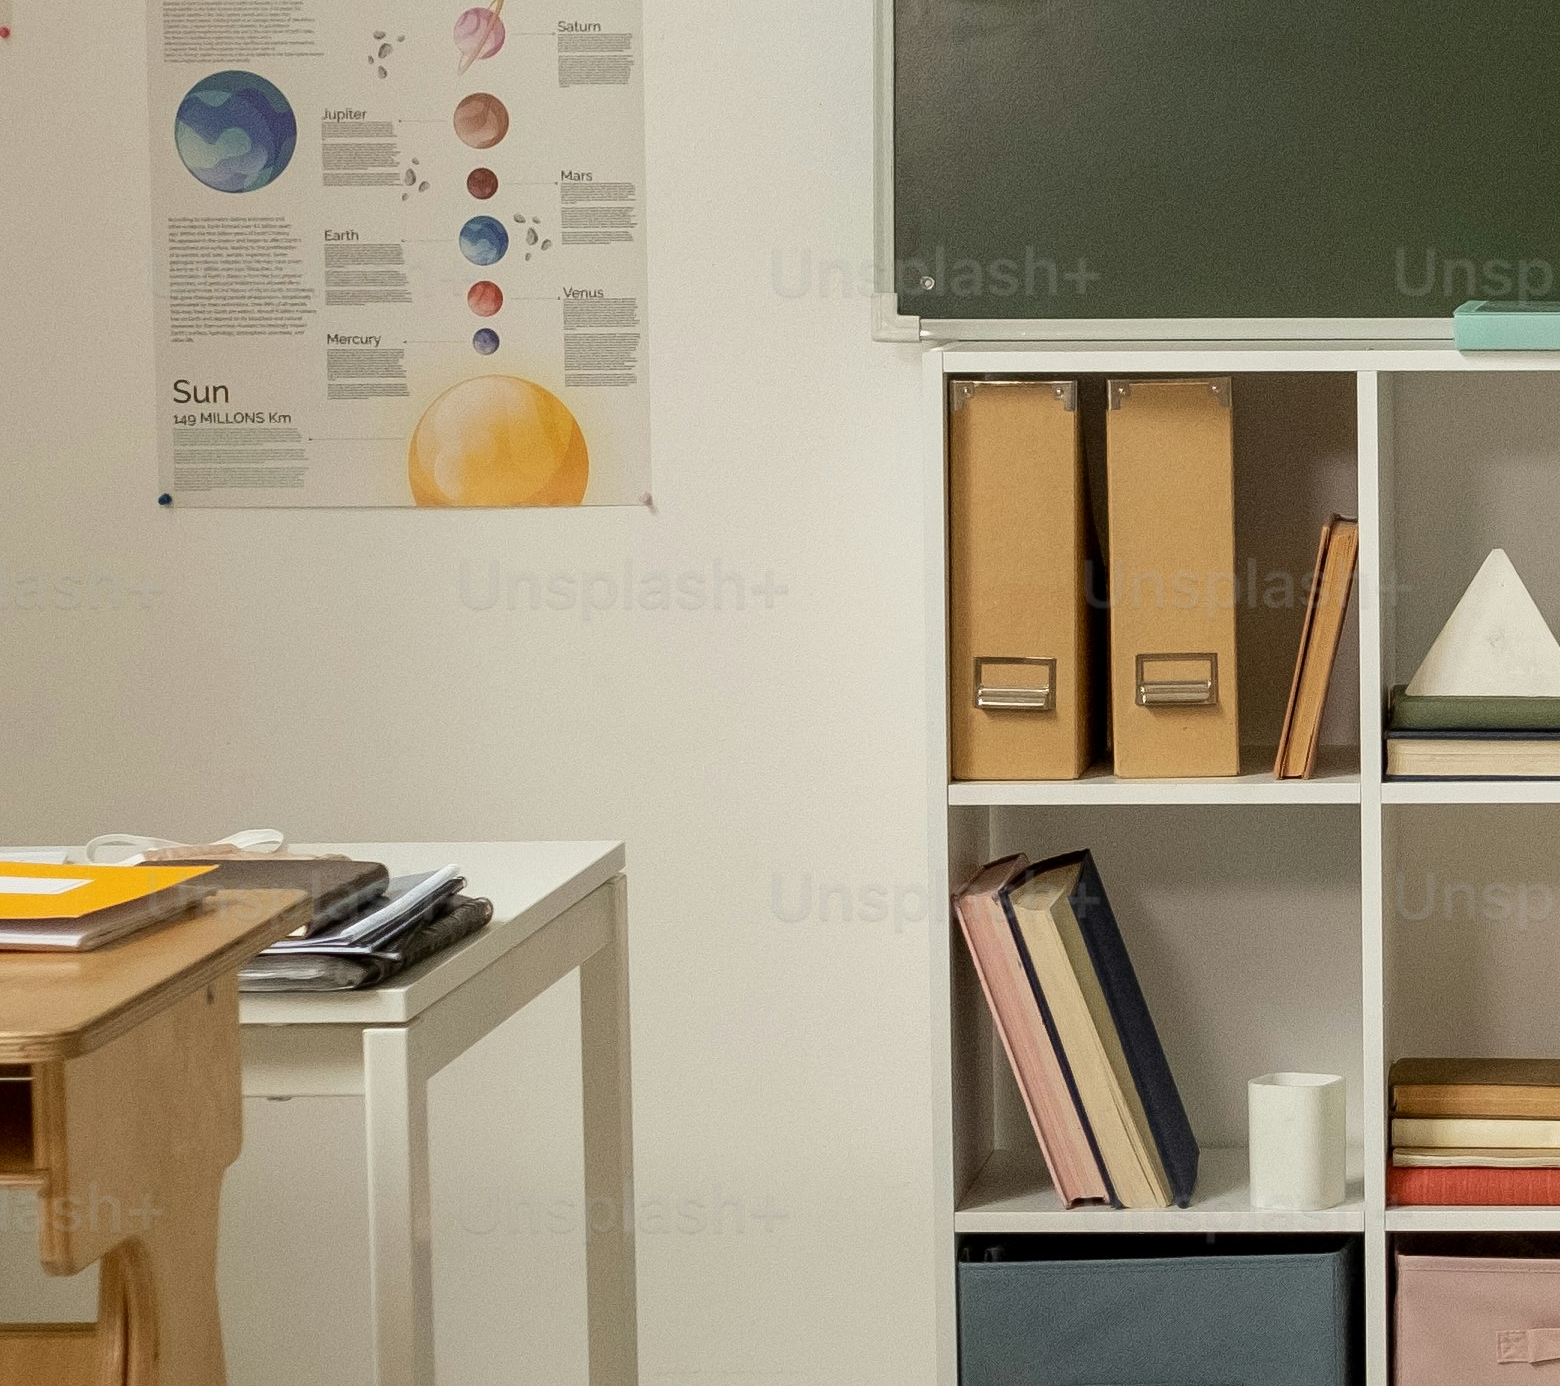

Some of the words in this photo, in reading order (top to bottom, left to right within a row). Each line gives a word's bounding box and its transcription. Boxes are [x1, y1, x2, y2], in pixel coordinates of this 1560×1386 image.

[557, 20, 602, 34] Saturn
[322, 107, 368, 125] Jupiter
[560, 169, 593, 183] Mars
[324, 229, 361, 243] Earth
[563, 286, 605, 300] Venus
[327, 332, 383, 350] Mercury
[172, 378, 230, 405] Sun
[173, 413, 197, 427] 149
[200, 412, 266, 424] MILLONS
[269, 412, 292, 424] Km
